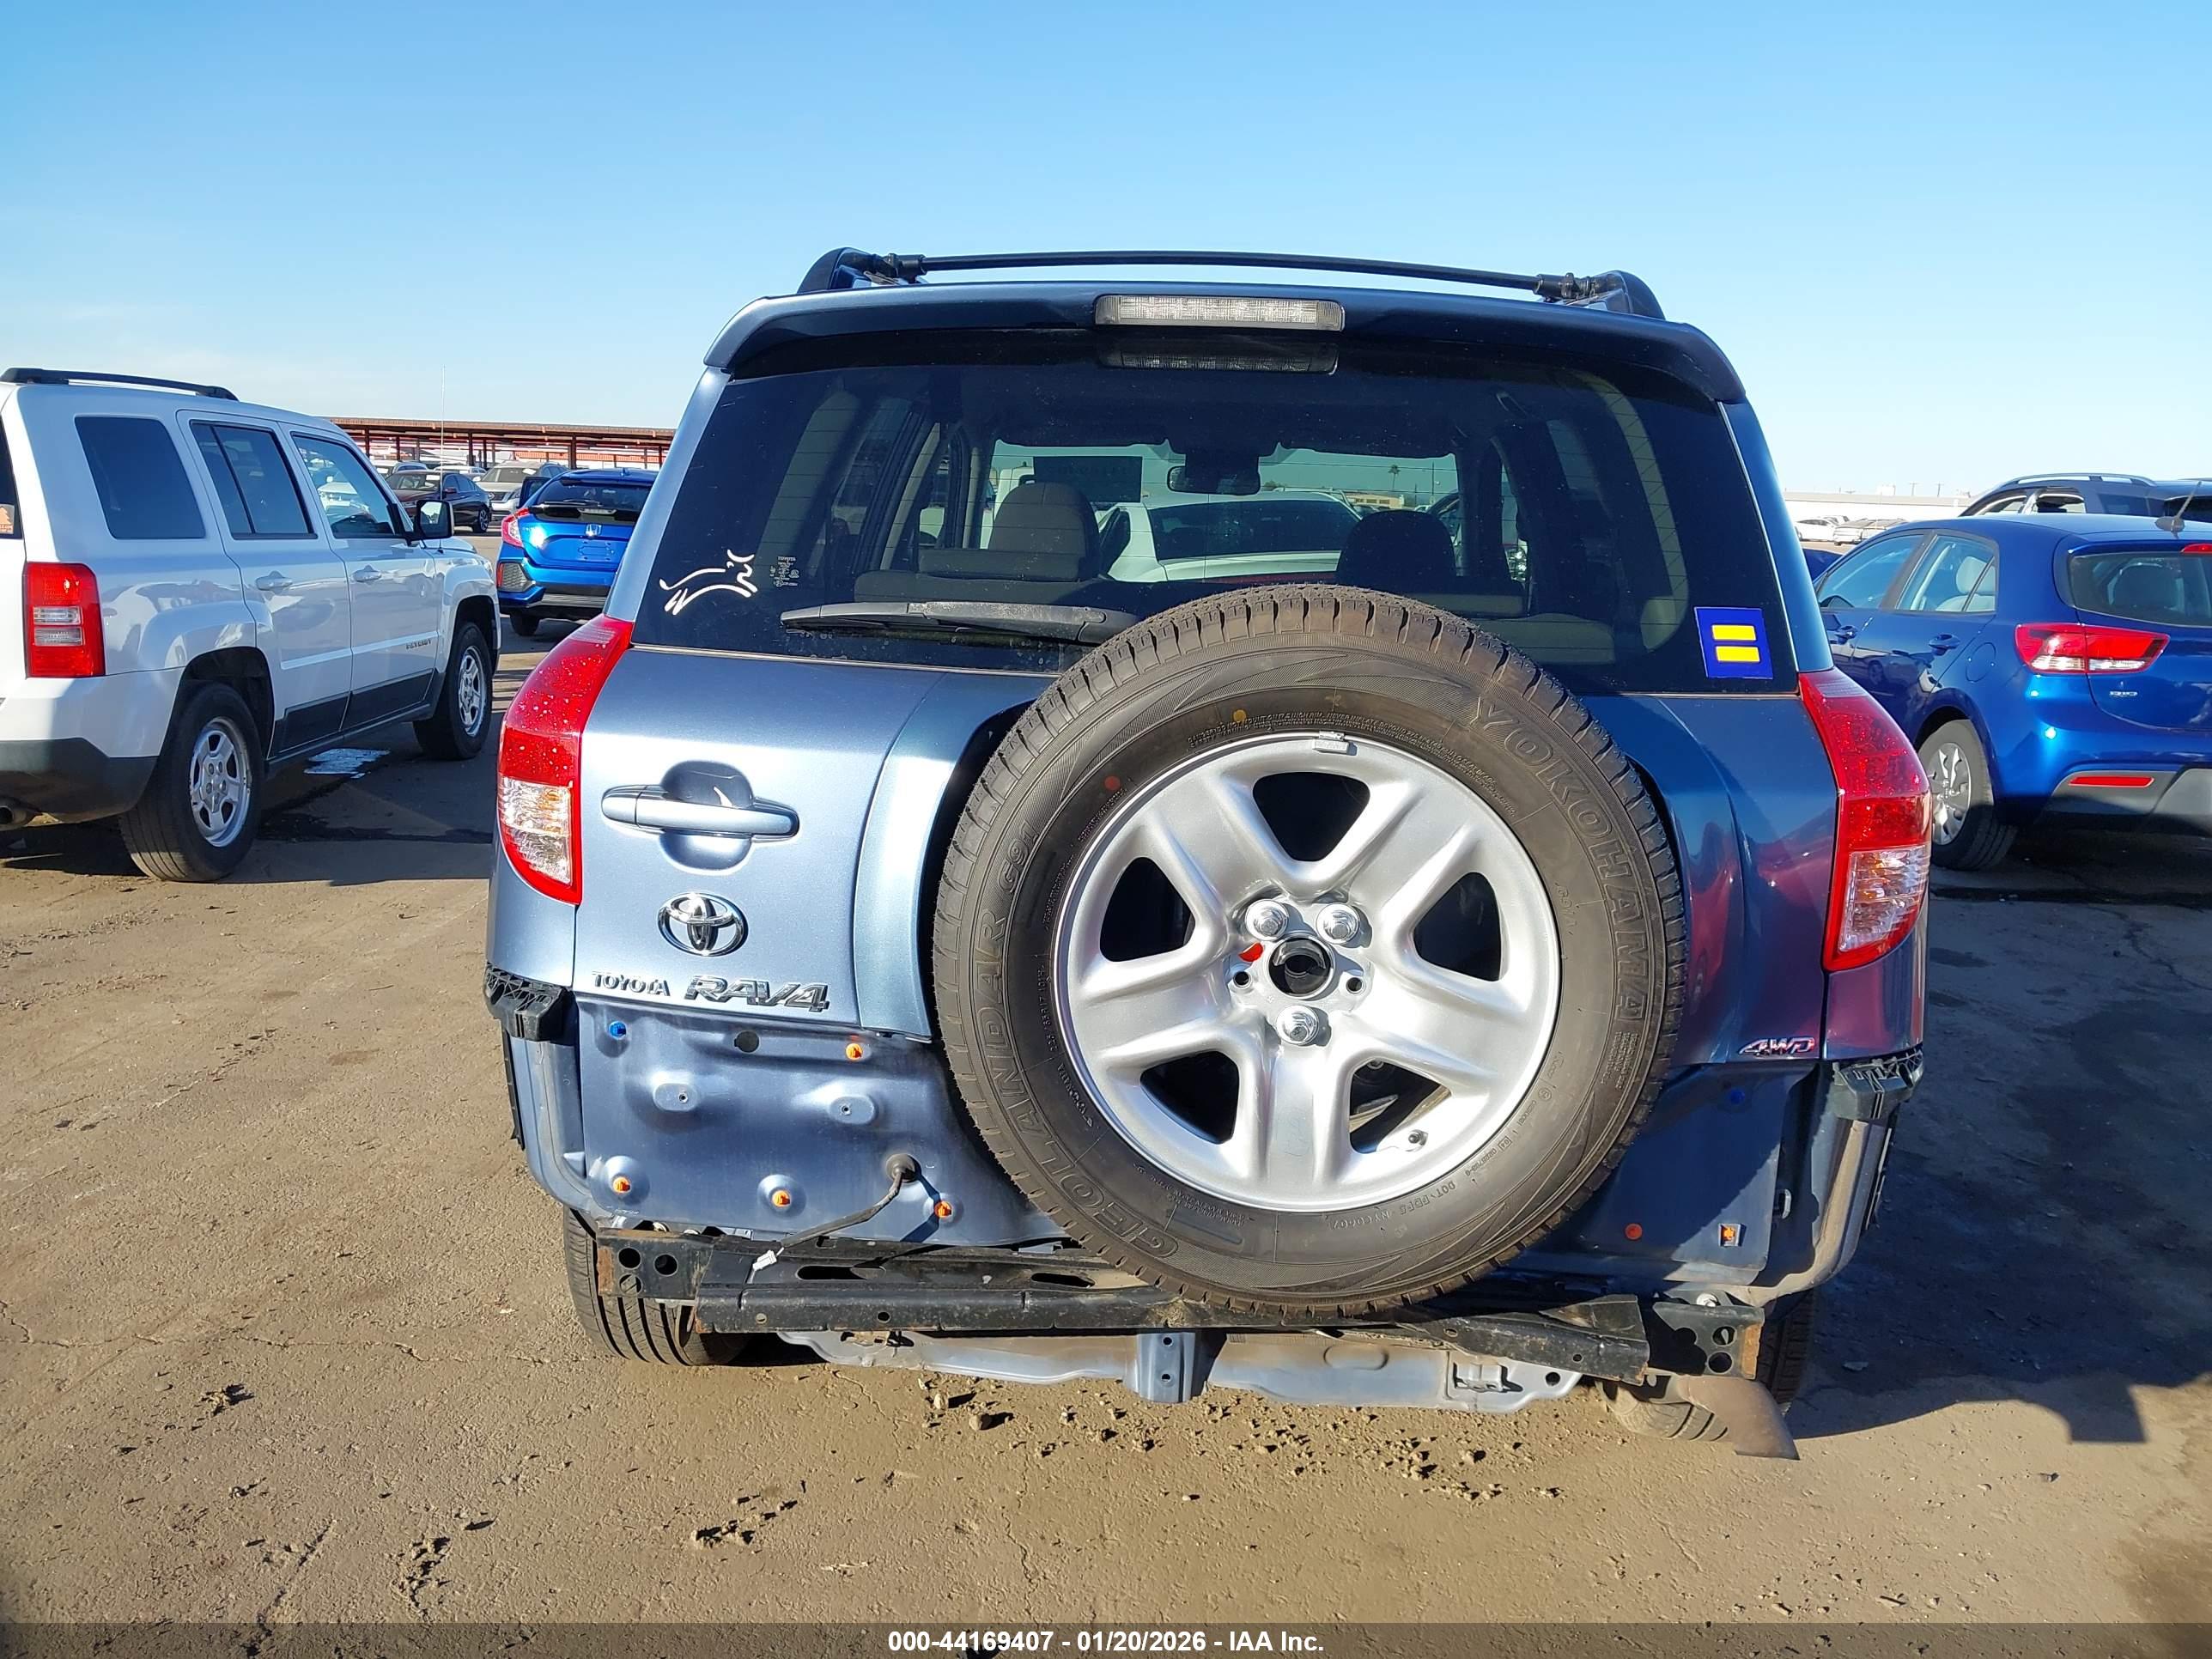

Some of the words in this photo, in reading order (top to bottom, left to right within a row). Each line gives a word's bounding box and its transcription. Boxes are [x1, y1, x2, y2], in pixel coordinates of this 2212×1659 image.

[1471, 696, 1650, 1021] YOKOHAMA
[684, 975, 830, 1013] RAV4
[1738, 1036, 1815, 1057] 4WD
